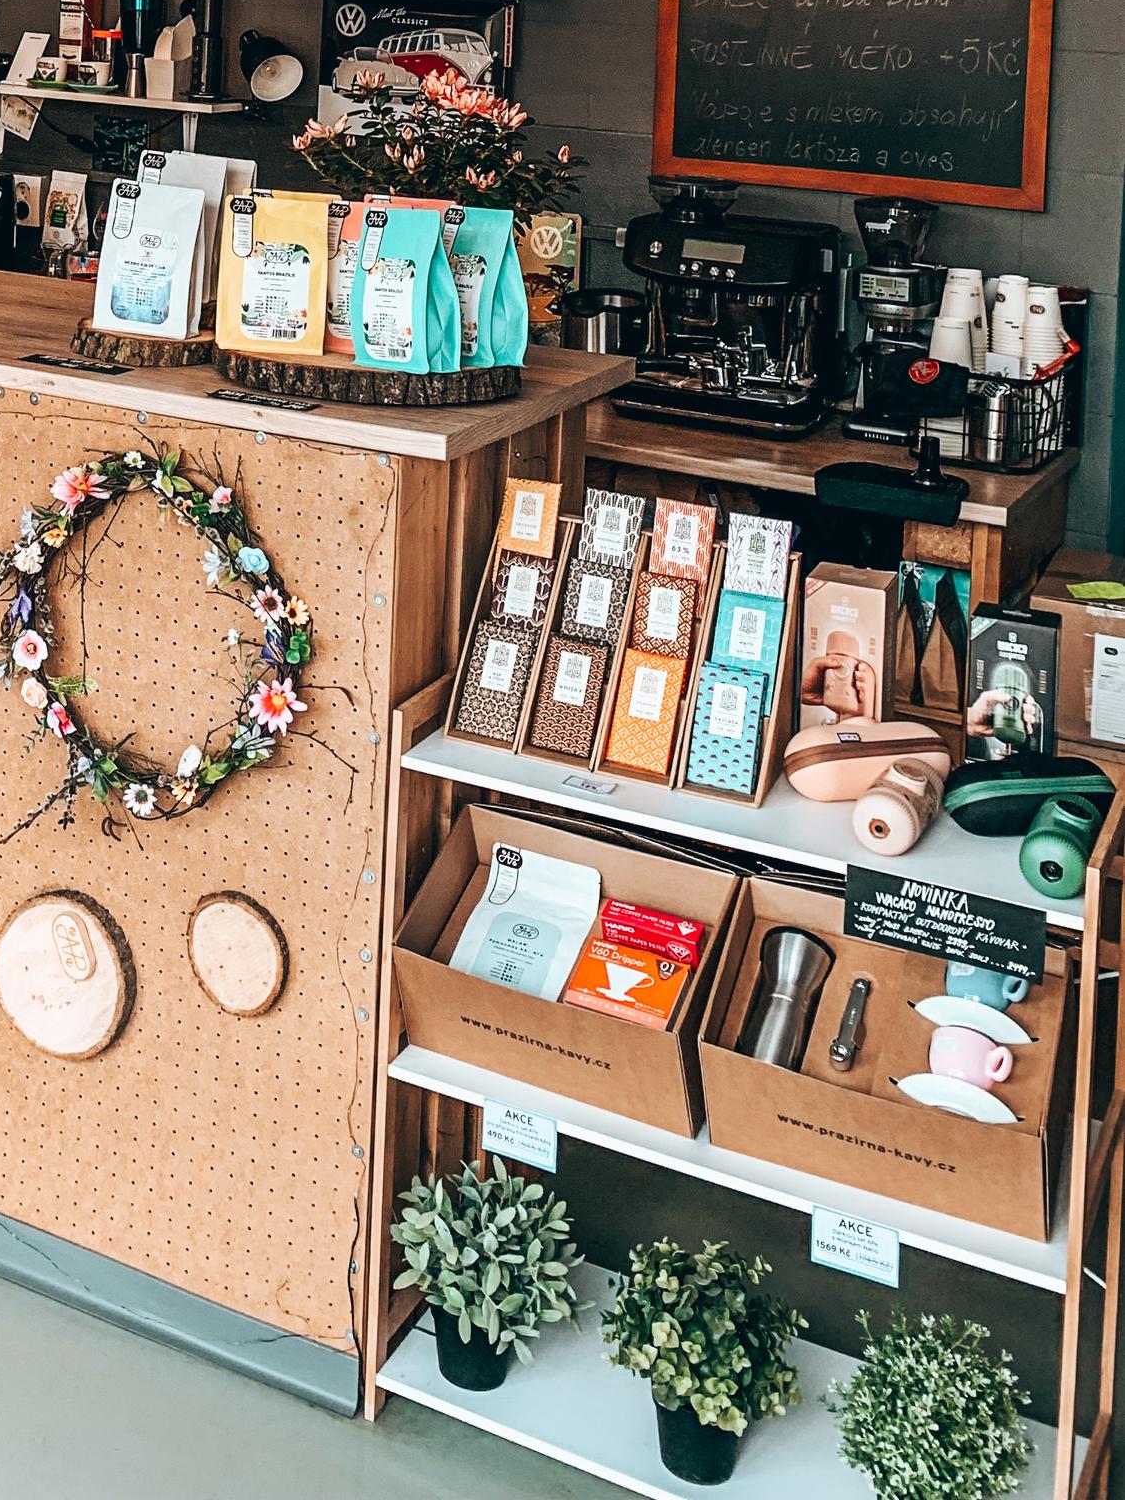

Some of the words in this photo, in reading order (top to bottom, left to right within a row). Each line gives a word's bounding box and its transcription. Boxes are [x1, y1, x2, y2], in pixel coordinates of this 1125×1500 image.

[900, 880, 969, 914] NOVINKA
[975, 931, 1020, 952] KÁVOVAR
[591, 946, 610, 957] V60
[611, 951, 646, 967] Dripper
[659, 961, 675, 973] 01
[460, 1013, 612, 1071] www.prazirna-kavy.cz
[505, 1110, 534, 1126] AKCE
[487, 1130, 503, 1140] 490
[776, 1113, 957, 1174] www.prazirna-kavy.cz
[839, 1218, 873, 1238] AKCE
[816, 1239, 837, 1252] 1569
[839, 1247, 851, 1258] Kč
